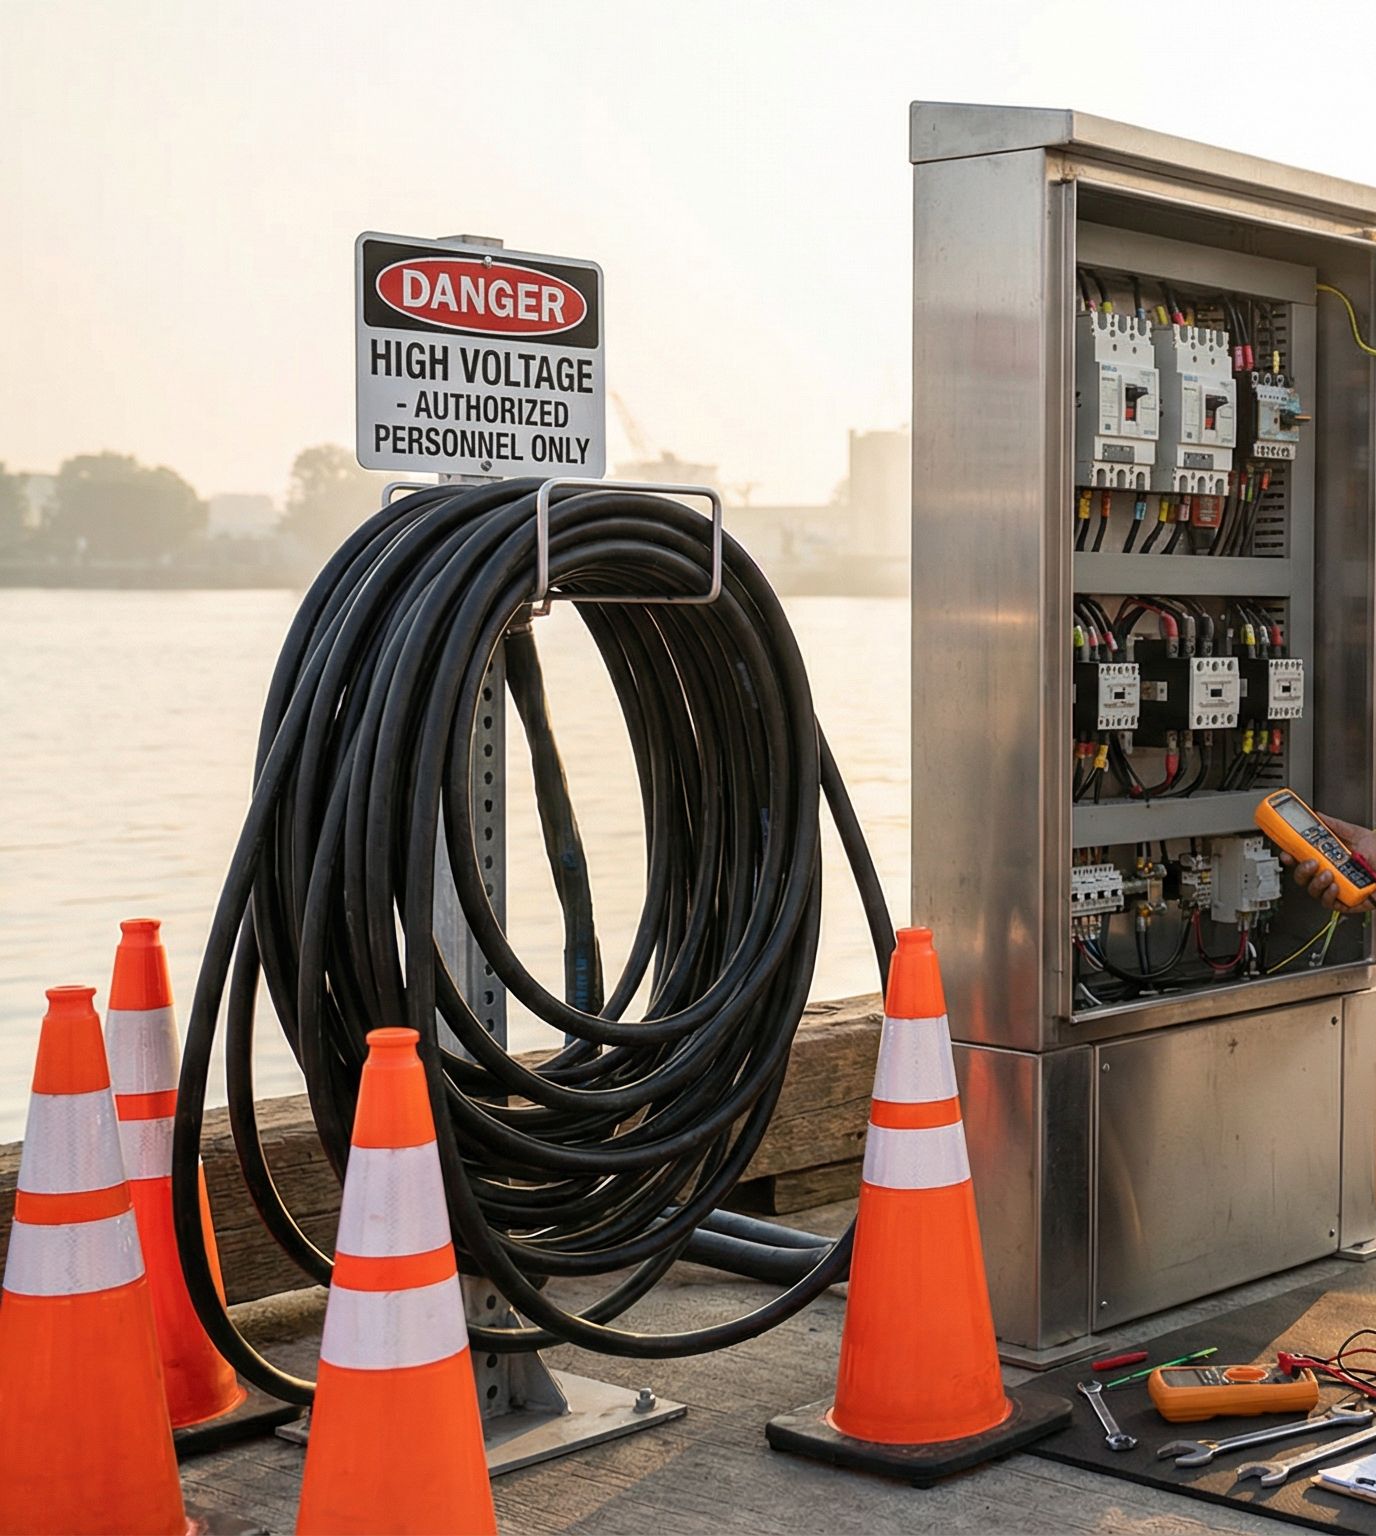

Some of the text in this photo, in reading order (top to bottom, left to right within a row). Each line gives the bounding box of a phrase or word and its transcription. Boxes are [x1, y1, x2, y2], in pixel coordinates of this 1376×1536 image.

[402, 268, 565, 324] DANGER
[370, 338, 594, 394] HIGH VOLTAGE
[414, 390, 569, 428] AUTHORIZED
[374, 423, 591, 465] PERSONNEL ONLY
